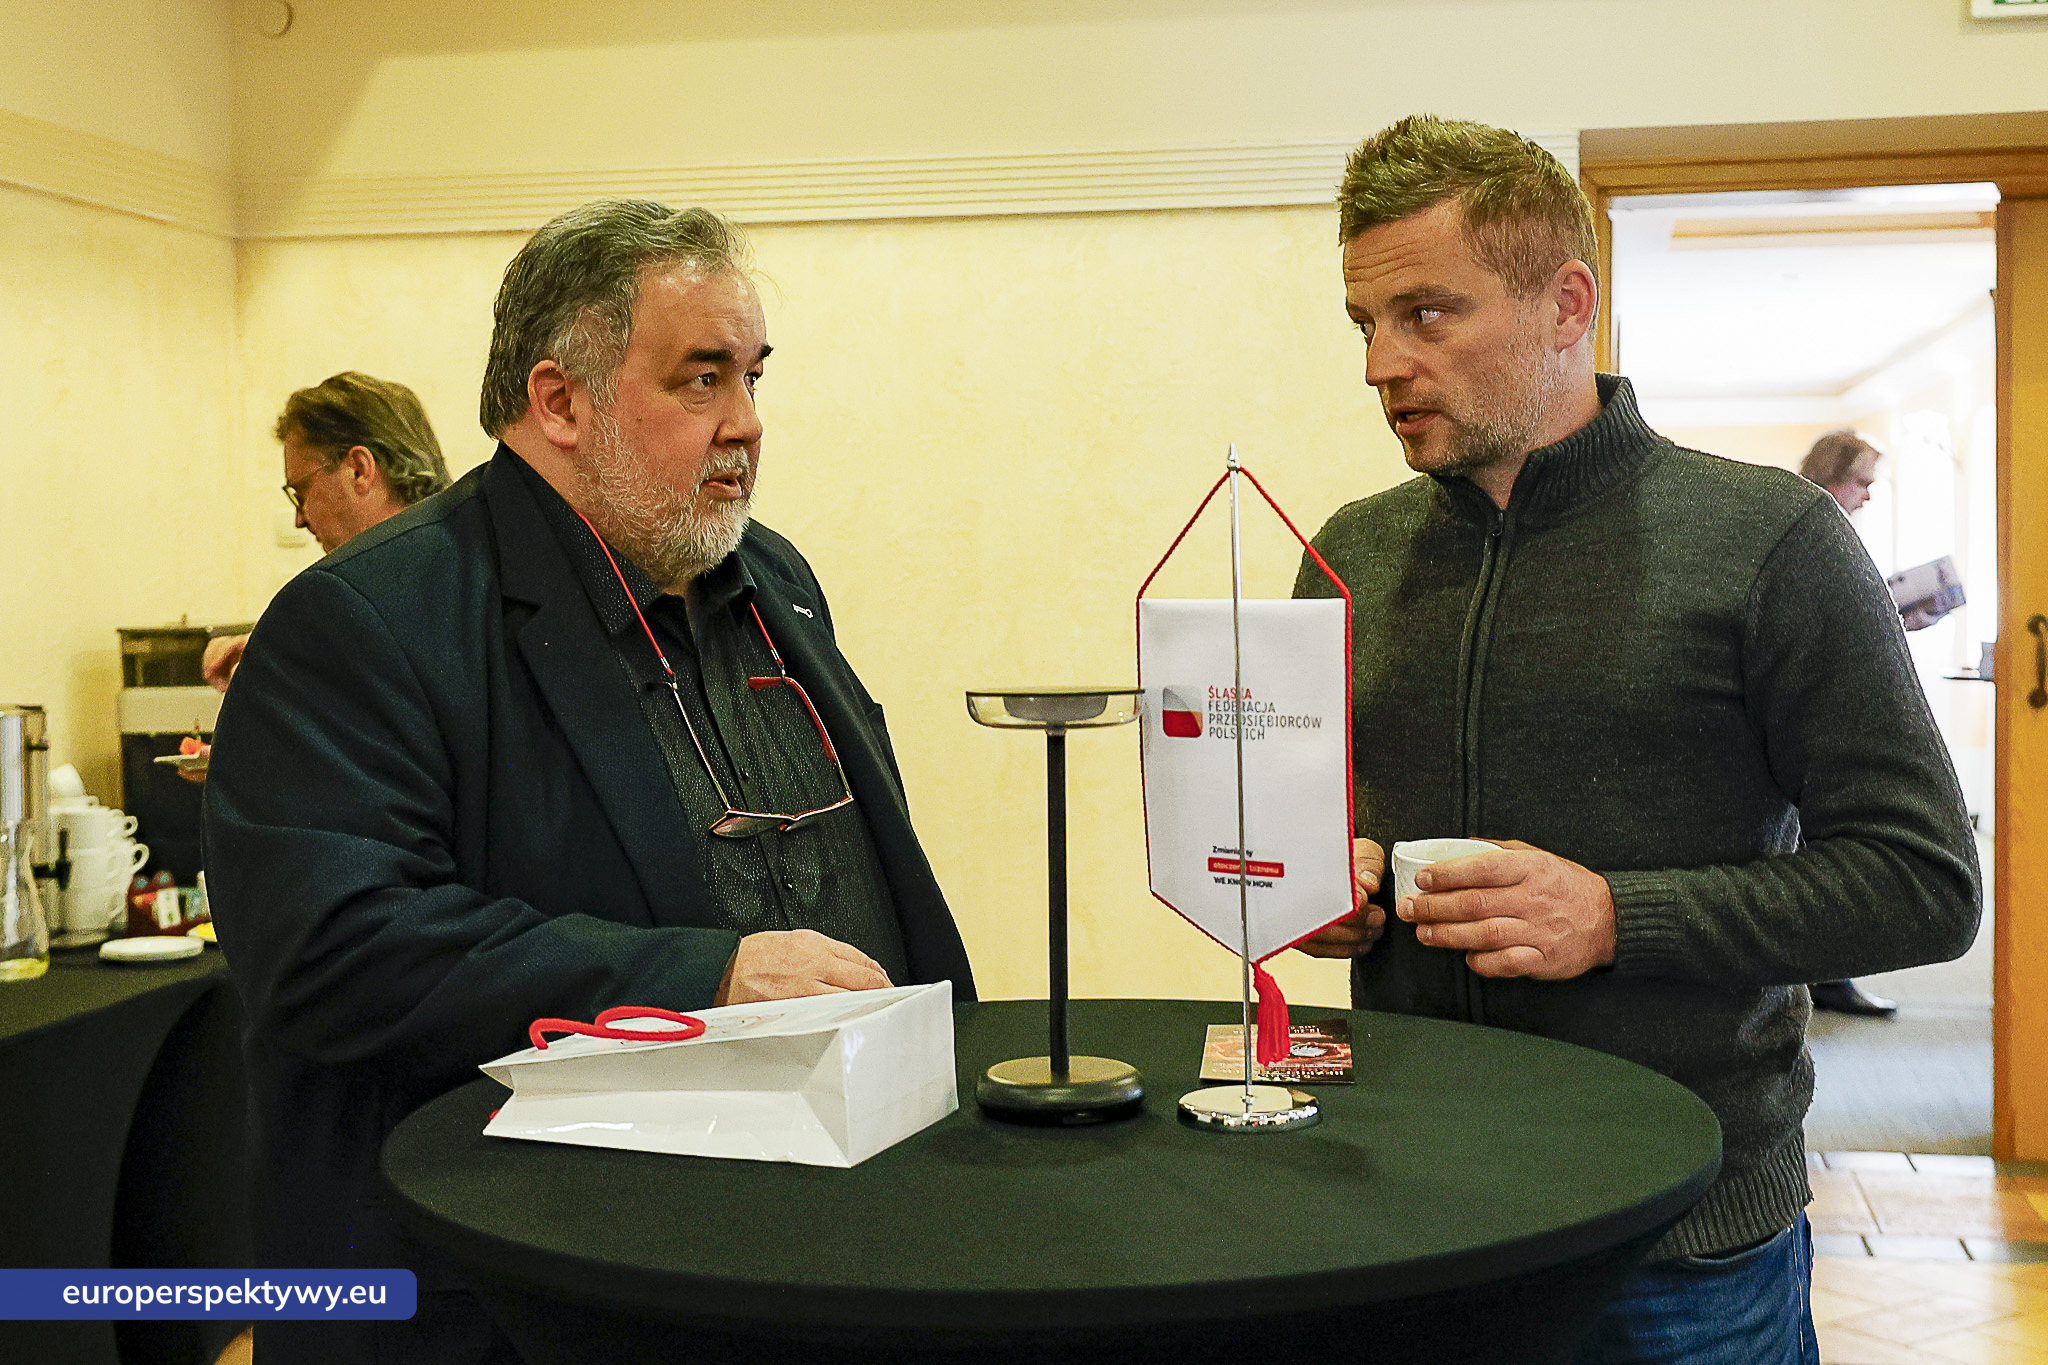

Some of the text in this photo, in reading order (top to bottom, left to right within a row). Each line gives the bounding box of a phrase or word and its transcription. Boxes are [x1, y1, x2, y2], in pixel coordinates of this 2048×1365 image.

[1209, 727, 1265, 740] POLSICH
[1213, 876, 1226, 885] WE
[1227, 878, 1252, 887] KNW
